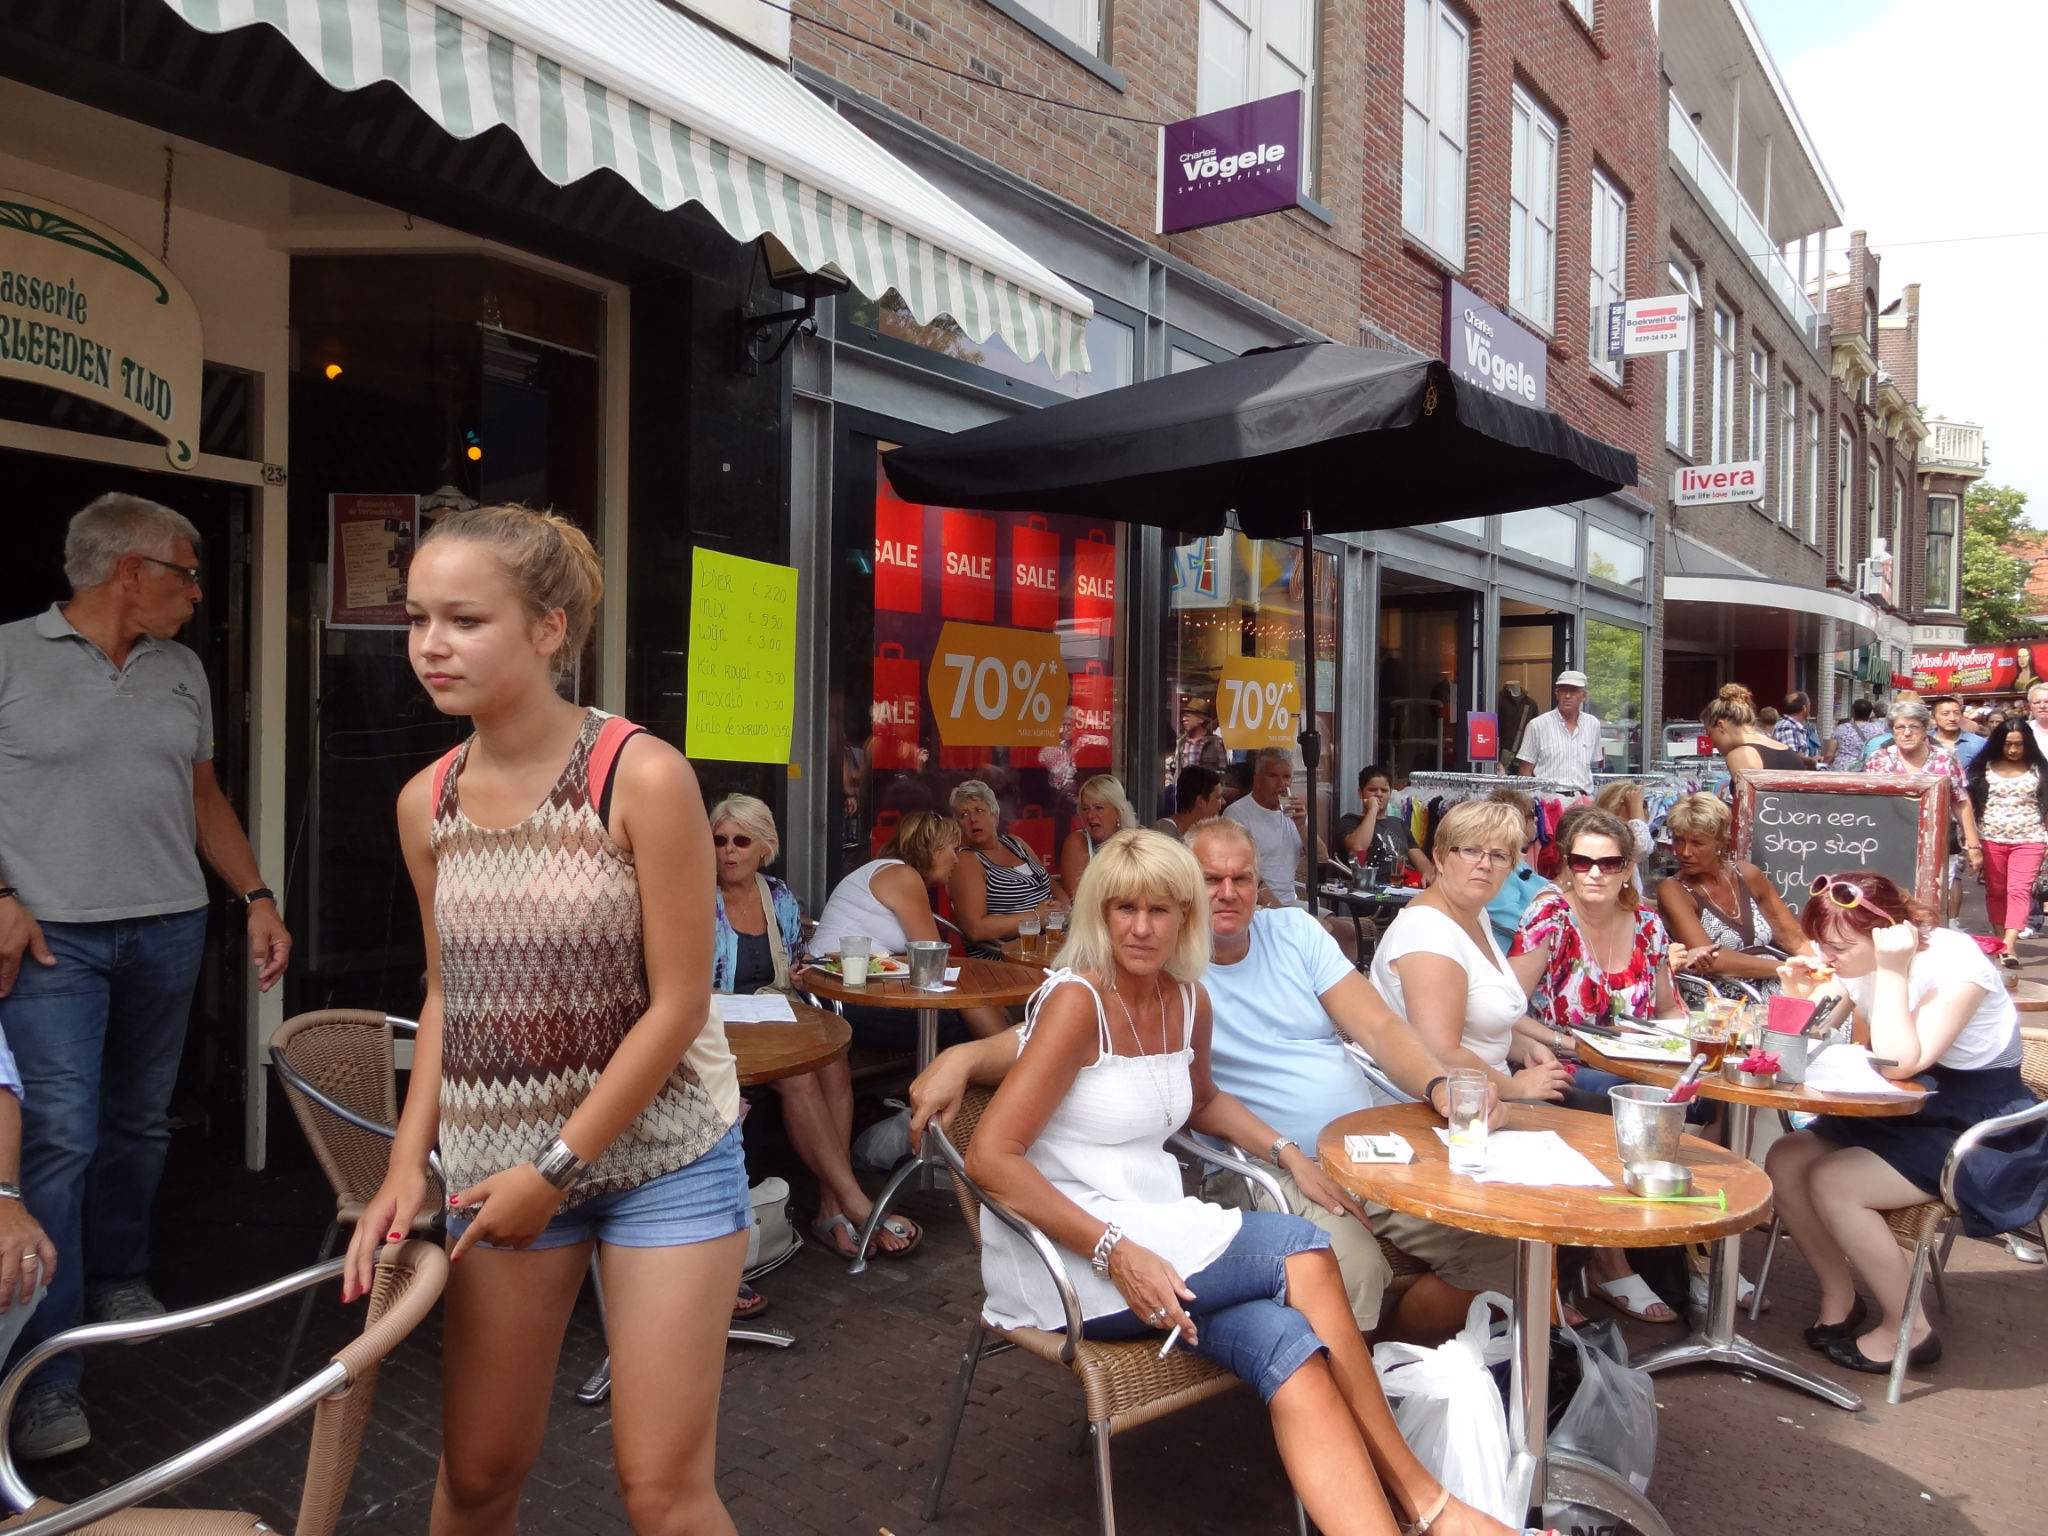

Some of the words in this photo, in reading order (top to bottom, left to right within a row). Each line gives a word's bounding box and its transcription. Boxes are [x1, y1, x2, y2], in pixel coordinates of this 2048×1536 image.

[1180, 148, 1217, 163] Charles
[1183, 143, 1285, 181] Vögele
[1179, 164, 1282, 194] Switzerland
[1464, 308, 1494, 338] Charles
[1612, 314, 1622, 339] HUUR
[1669, 314, 1687, 323] Olie
[1611, 340, 1621, 350] TE
[1464, 325, 1537, 402] Vögele
[121, 356, 173, 421] TIJD
[266, 466, 283, 483] 23
[1682, 469, 1755, 491] livera
[1682, 493, 1696, 501] live
[1698, 491, 1711, 500] life
[1712, 490, 1728, 499] love
[1731, 488, 1754, 497] livera
[946, 551, 992, 580] SALE
[1016, 563, 1057, 590] SALE
[1077, 574, 1114, 600] SALE
[1944, 648, 1995, 671] Mystery
[1075, 708, 1112, 731] SALE
[1758, 797, 1821, 826] Even
[1827, 812, 1877, 827] een
[1764, 829, 1818, 861] shop
[1823, 833, 1880, 866] stop
